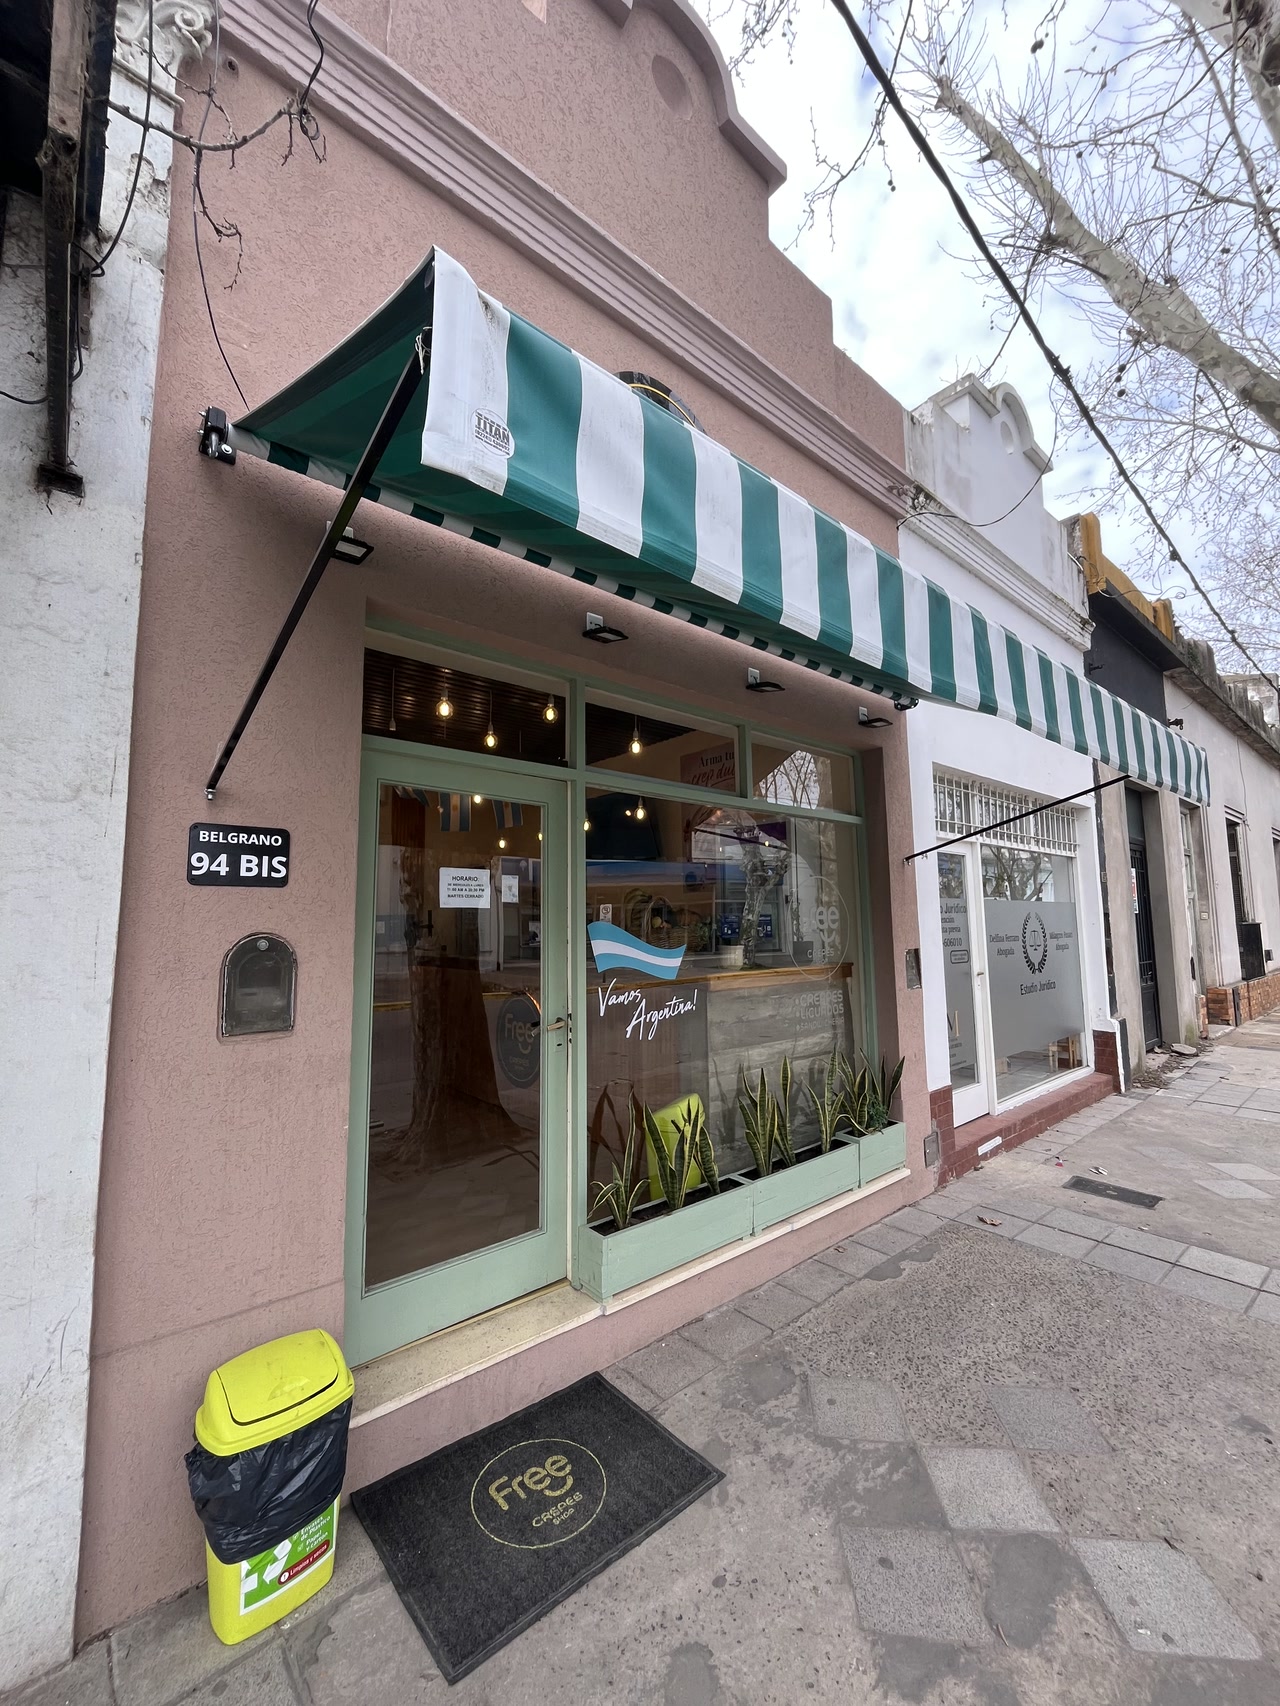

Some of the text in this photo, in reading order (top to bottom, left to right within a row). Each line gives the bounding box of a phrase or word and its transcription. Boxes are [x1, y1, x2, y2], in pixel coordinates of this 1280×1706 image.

[475, 414, 510, 444] TITAN
[699, 755, 723, 768] Arma
[199, 830, 282, 846] BELGRANO
[190, 852, 287, 878] 94 BIS
[598, 977, 698, 1040] Vamos Argentina!
[504, 1013, 535, 1043] Free
[488, 1455, 572, 1511] Free
[552, 1507, 575, 1525] SHOP
[306, 1530, 322, 1546] Papel
[289, 1558, 310, 1576] Limpios
